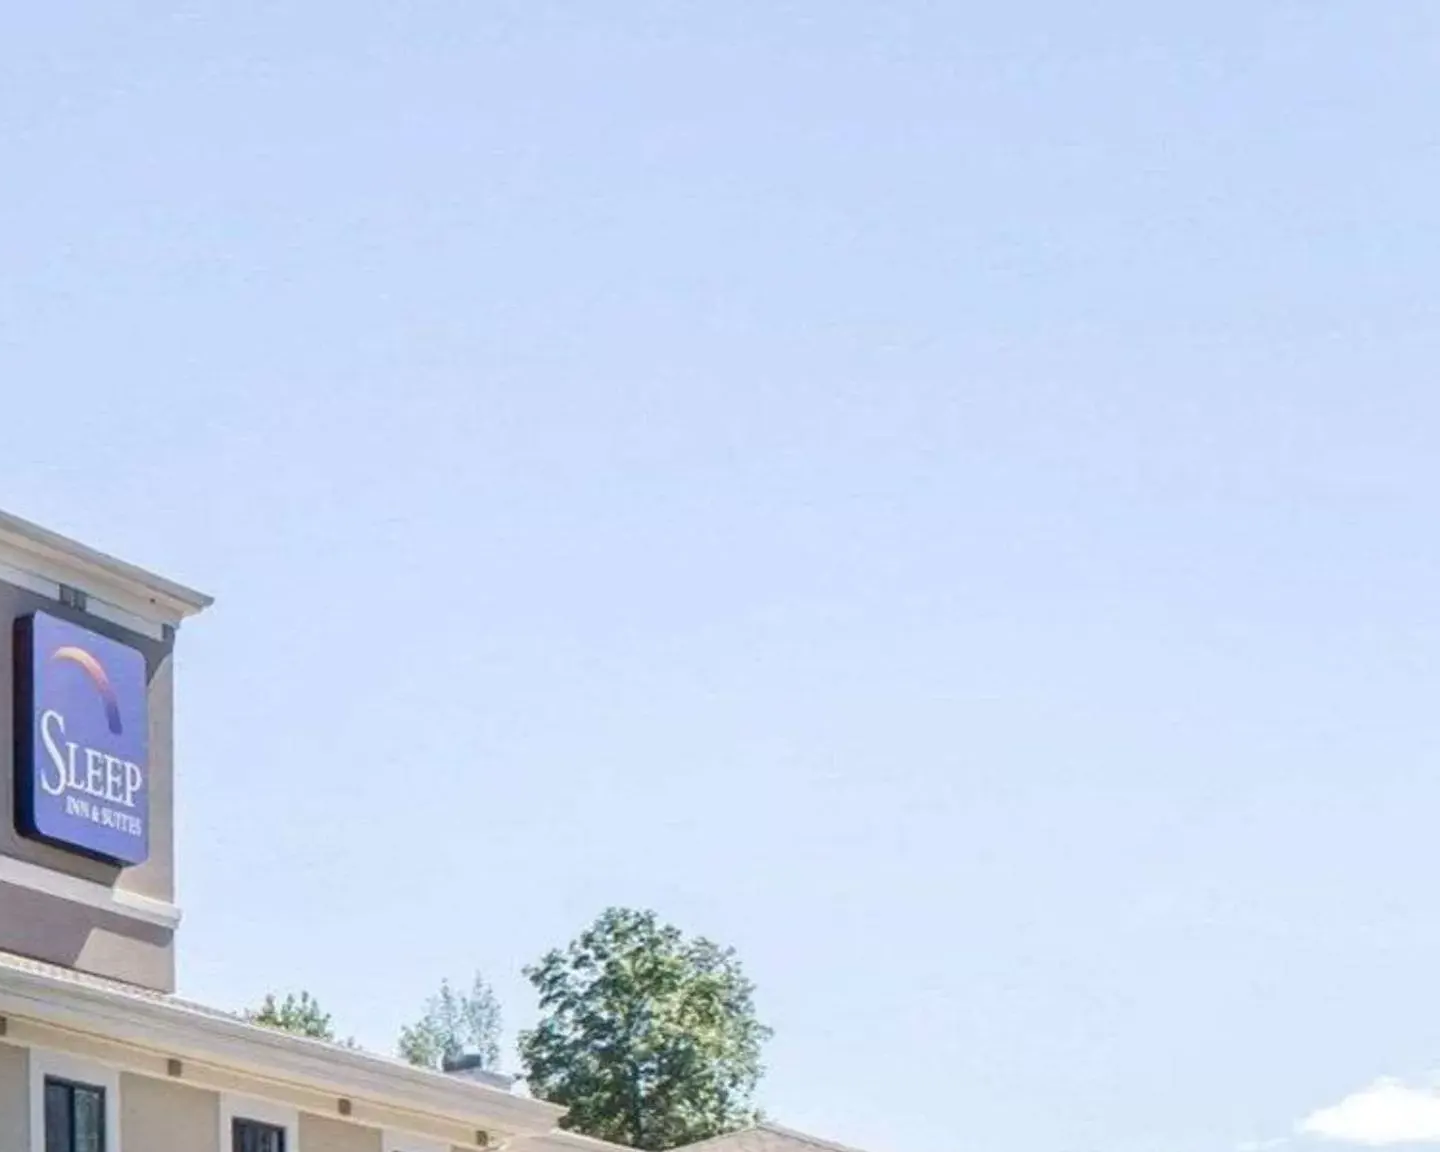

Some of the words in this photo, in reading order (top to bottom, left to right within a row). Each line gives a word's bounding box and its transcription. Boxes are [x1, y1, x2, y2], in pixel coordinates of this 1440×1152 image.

[40, 709, 143, 808] SLEEP
[65, 795, 90, 819] INN
[100, 806, 143, 837] SUITES
